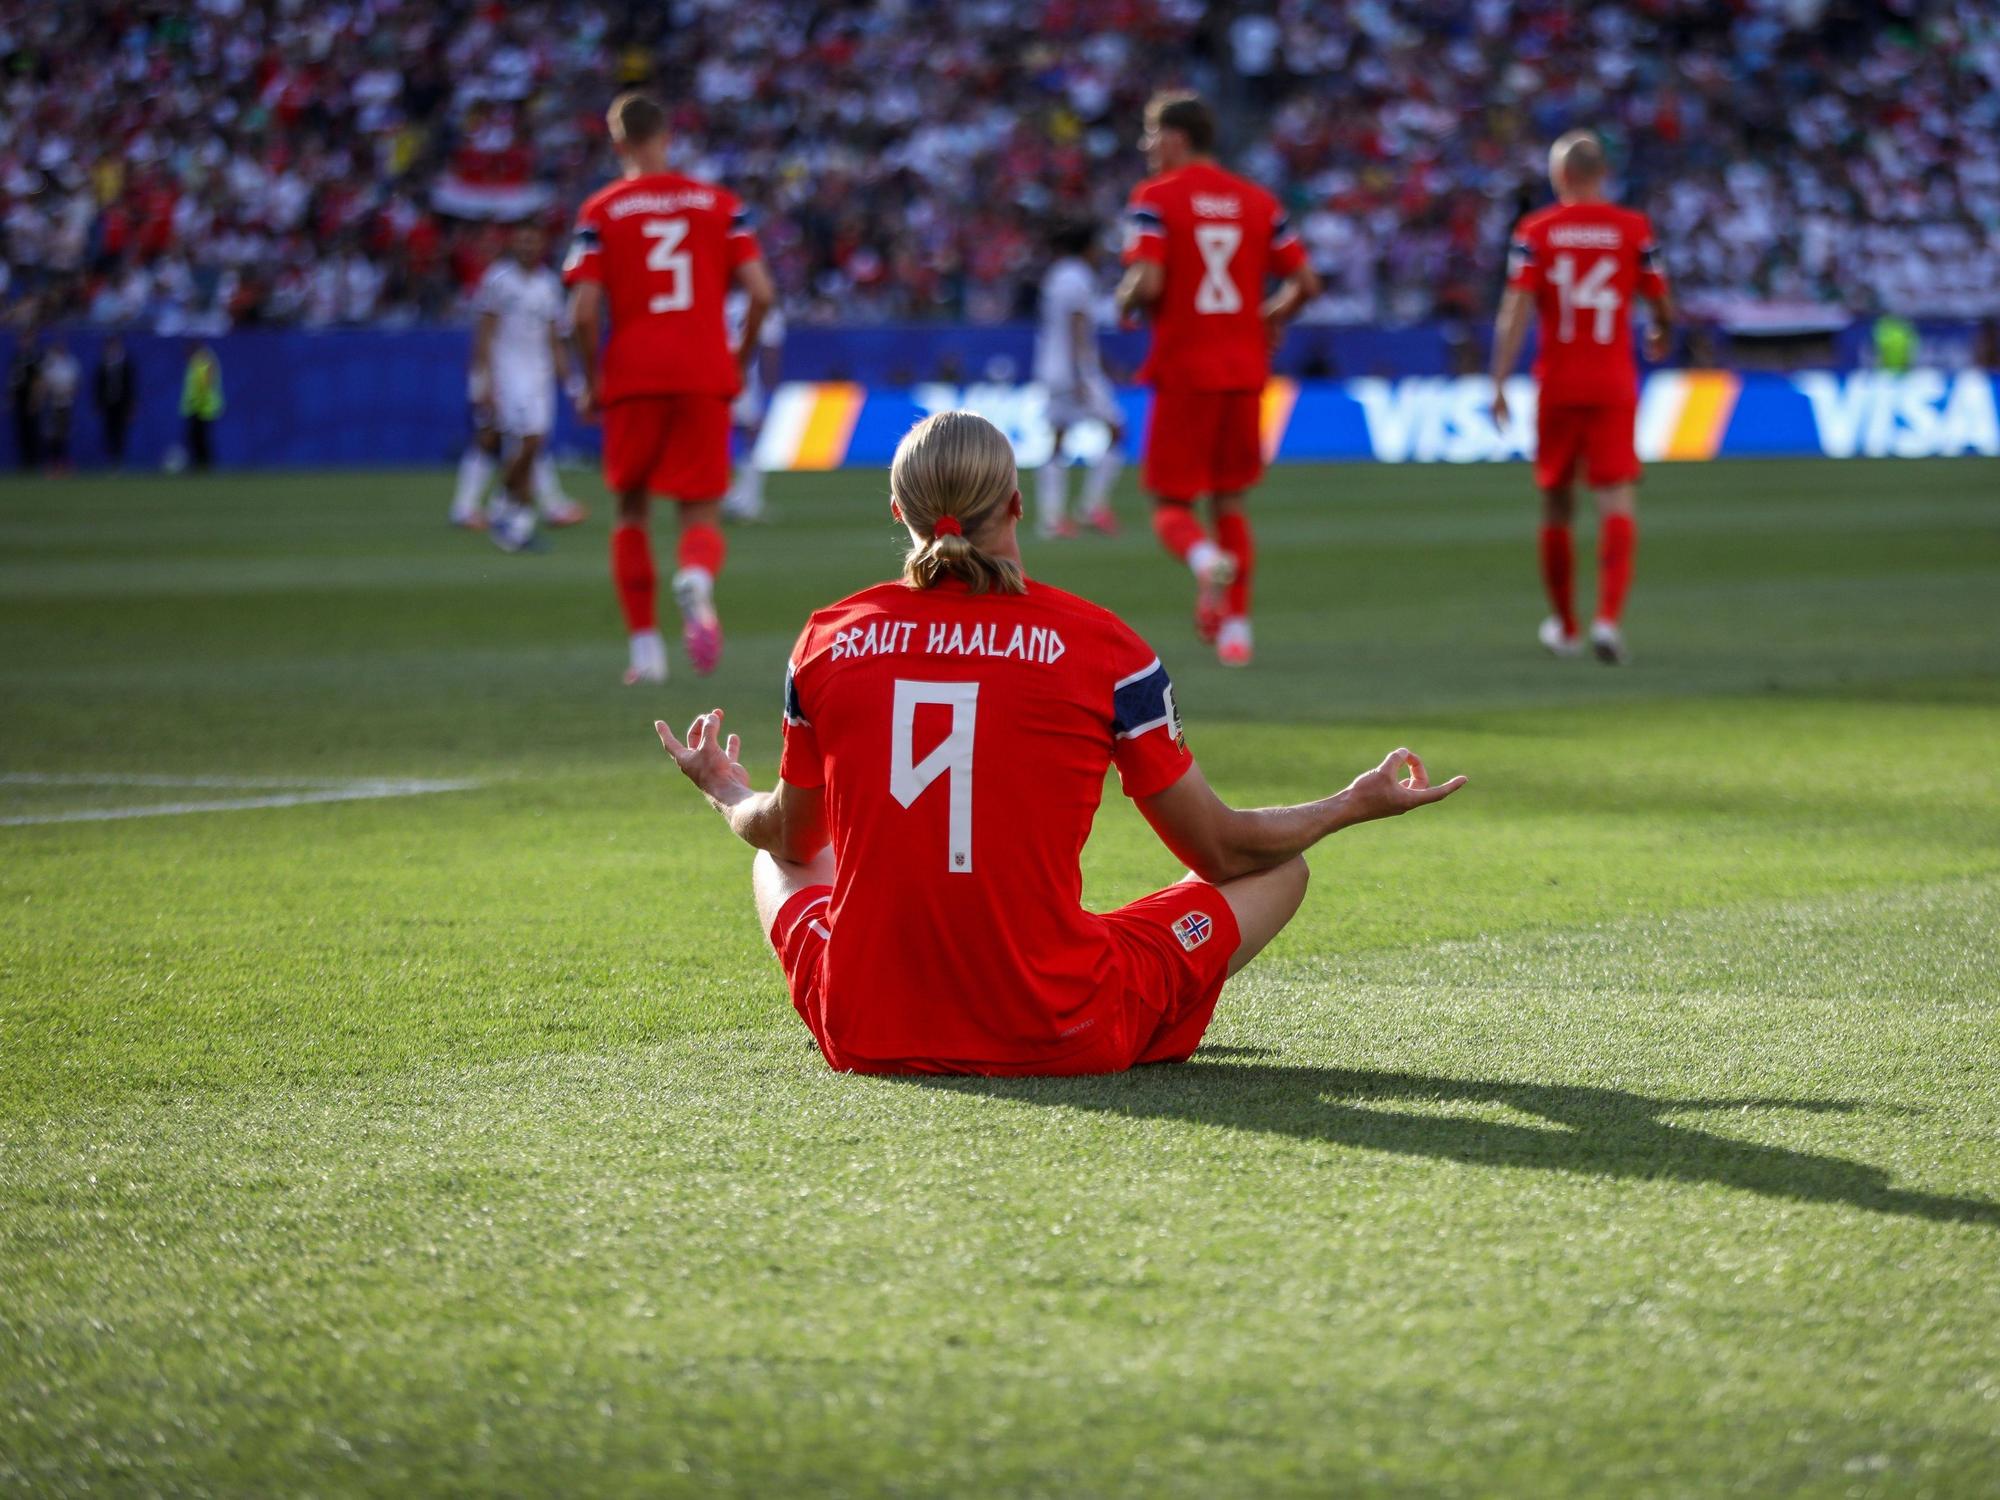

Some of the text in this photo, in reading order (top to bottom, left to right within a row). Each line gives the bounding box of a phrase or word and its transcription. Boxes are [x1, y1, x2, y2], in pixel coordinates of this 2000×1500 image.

[642, 218, 693, 313] 3
[1194, 223, 1243, 315] 8
[1547, 253, 1621, 344] 14
[1797, 371, 2000, 458] VISA
[831, 622, 1066, 664] BRAUT HAALAND
[889, 679, 980, 873] 9
